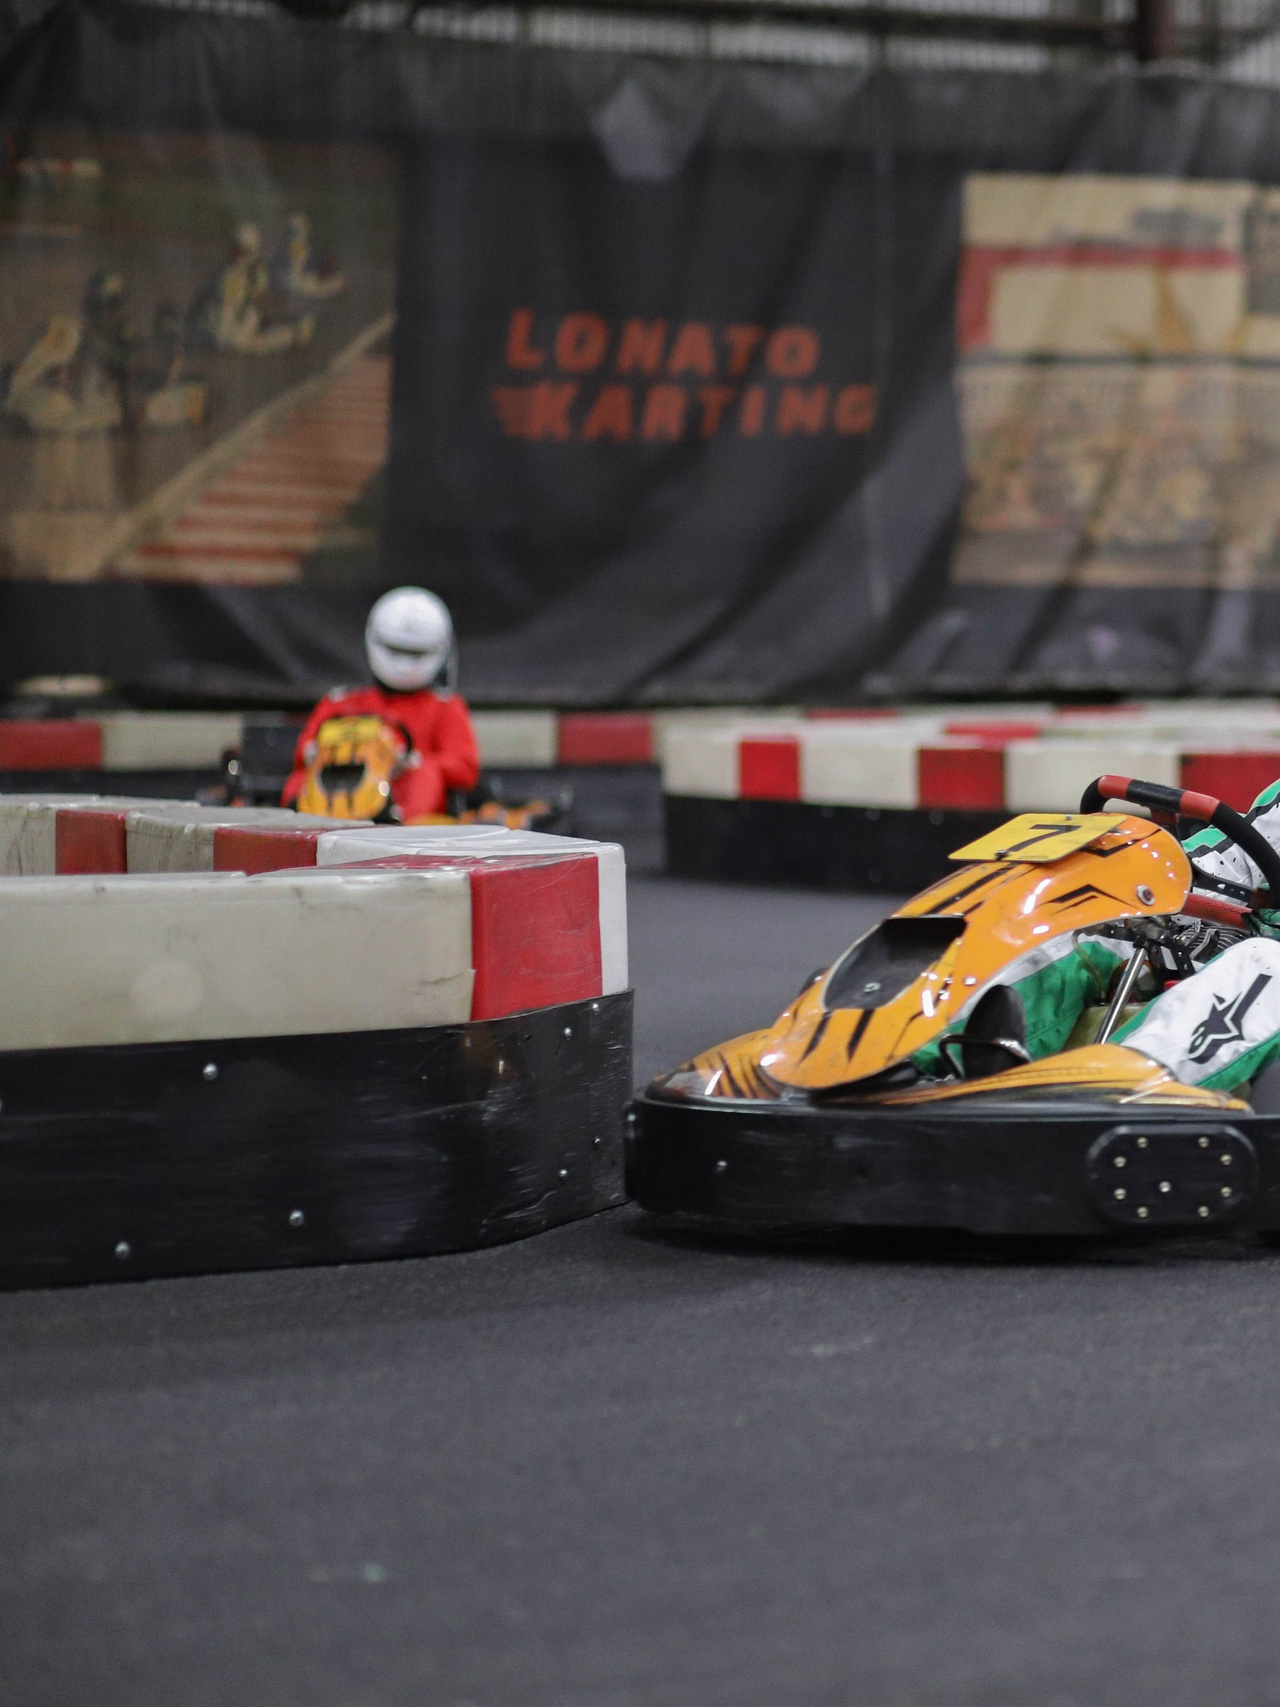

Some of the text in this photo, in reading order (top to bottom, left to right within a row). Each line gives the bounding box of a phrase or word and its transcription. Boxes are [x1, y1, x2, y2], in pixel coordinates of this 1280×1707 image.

[506, 307, 820, 378] LONATO
[518, 380, 879, 442] KARTING
[1007, 824, 1083, 853] 7
